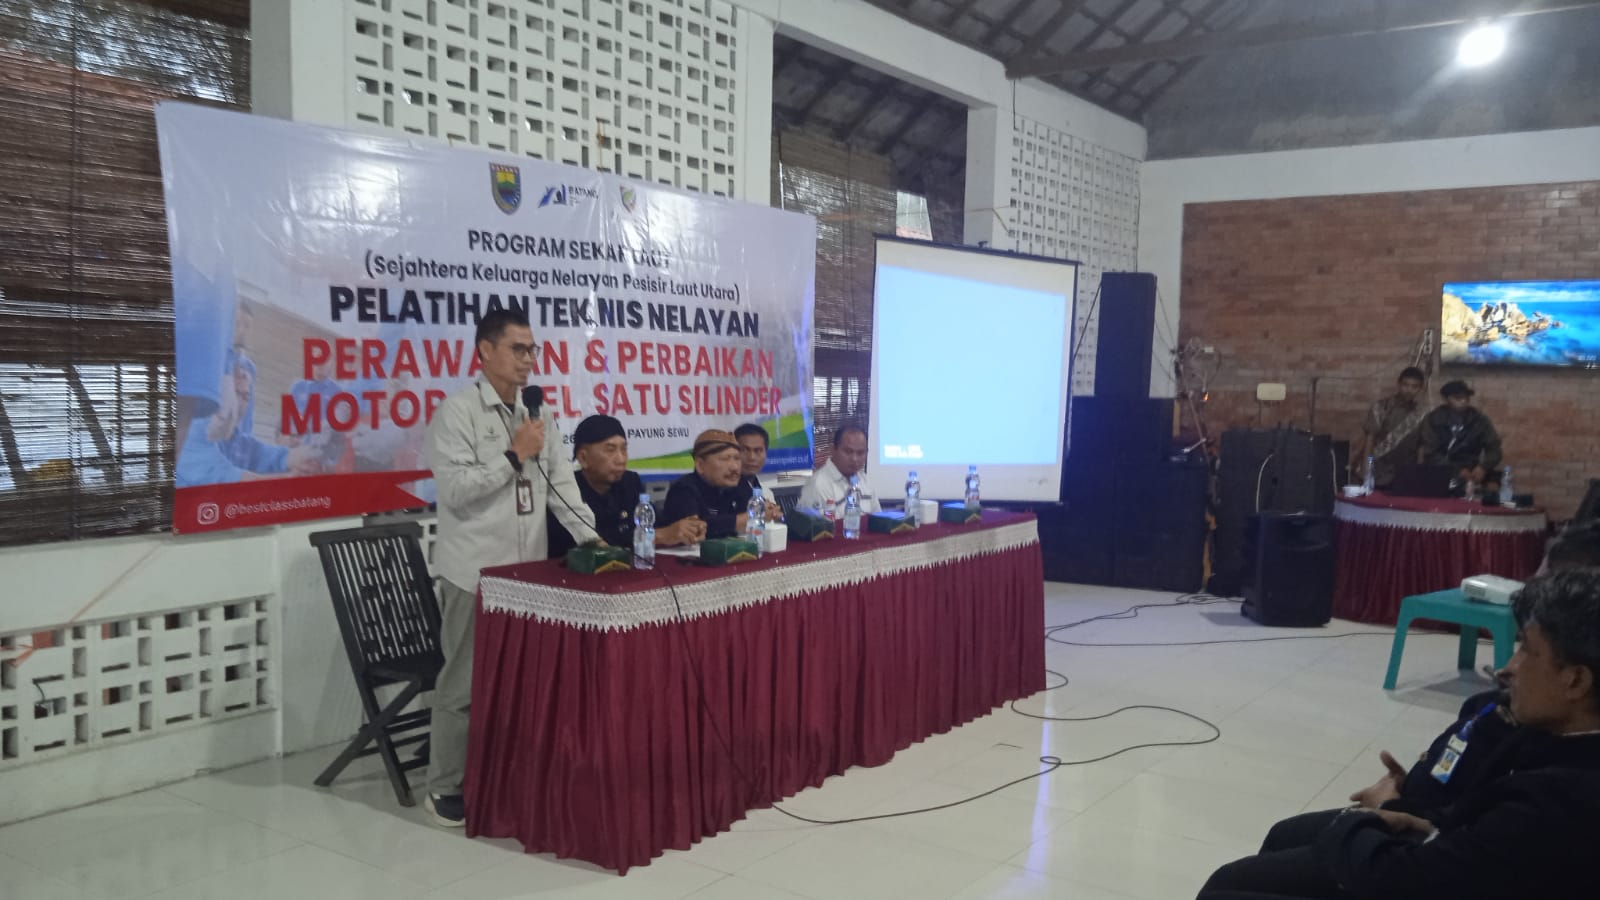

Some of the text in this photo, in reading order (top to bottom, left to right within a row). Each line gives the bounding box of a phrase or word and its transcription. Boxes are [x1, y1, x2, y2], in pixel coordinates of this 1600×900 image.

[468, 229, 565, 260] PROGRAM
[365, 249, 740, 305] (Sejahtera Keluarga Nelayan Pesisir Laut Utara)
[329, 286, 530, 326] PELATIHAN
[648, 303, 759, 338] NELAYAN
[303, 337, 774, 380] PERAWN & PERBAIKAN
[595, 383, 671, 416] SATU
[679, 386, 782, 416] SILINDER
[627, 428, 665, 439] PAYUNG
[667, 428, 689, 438] SEWU
